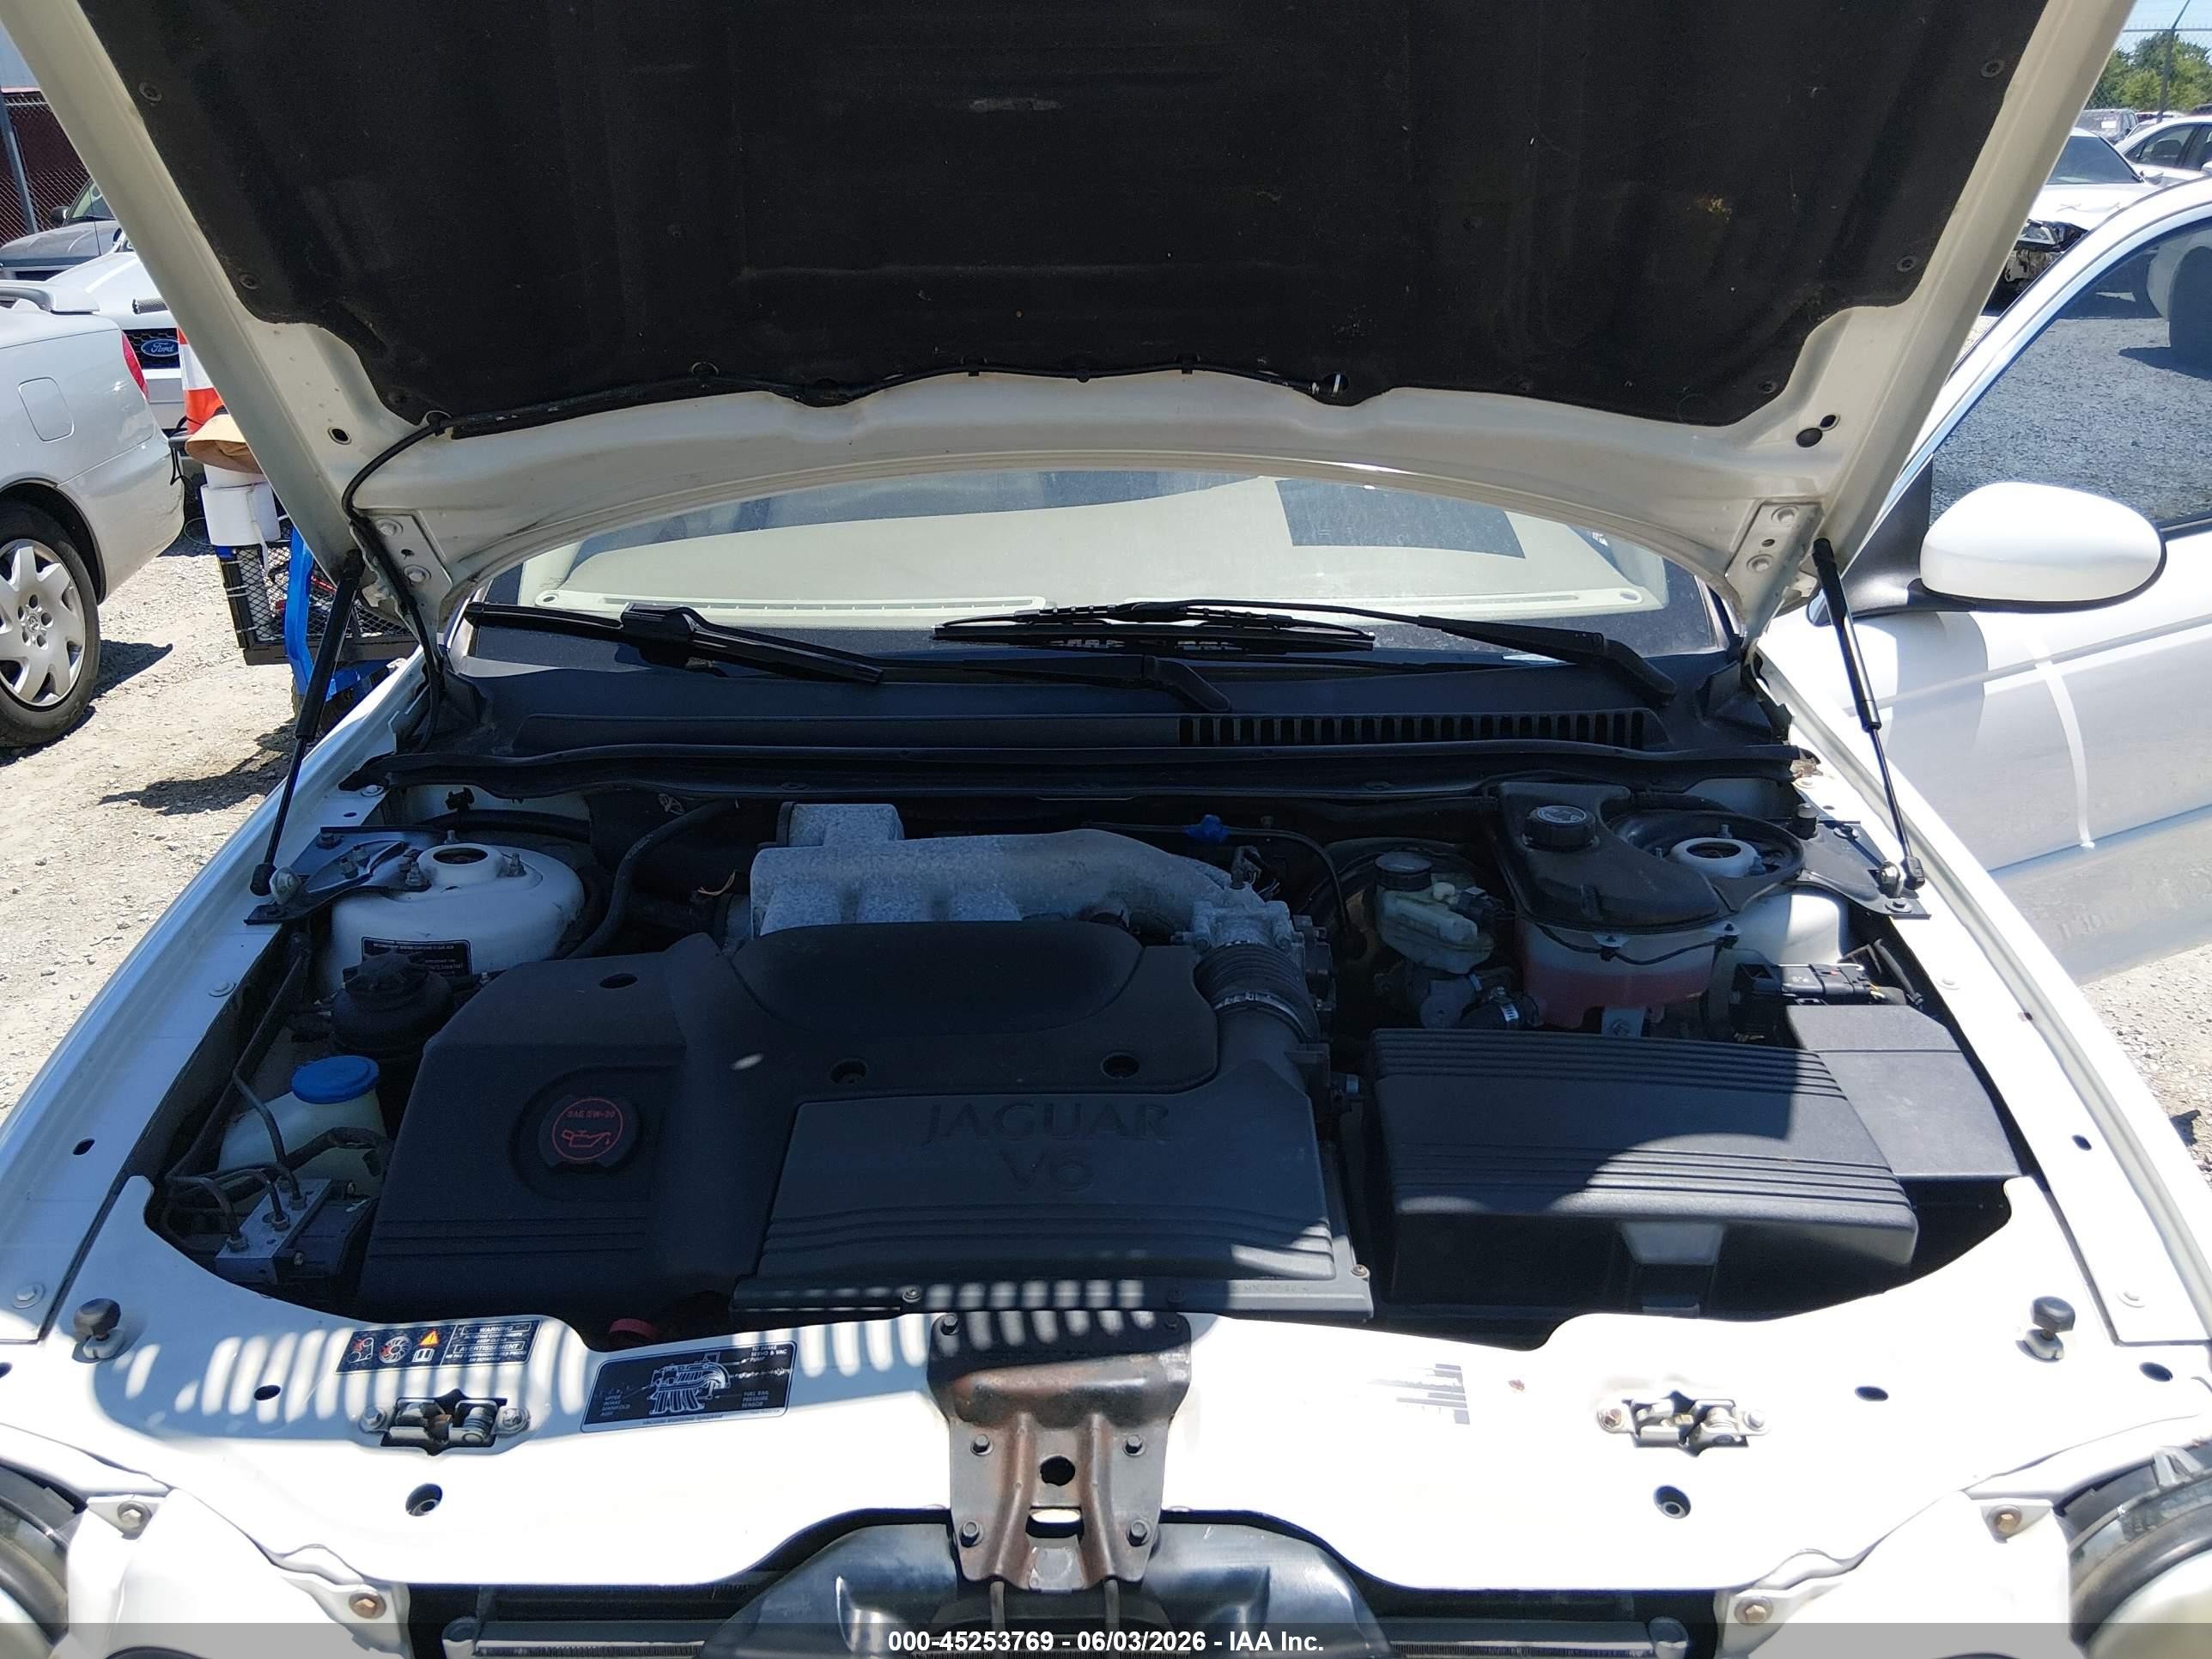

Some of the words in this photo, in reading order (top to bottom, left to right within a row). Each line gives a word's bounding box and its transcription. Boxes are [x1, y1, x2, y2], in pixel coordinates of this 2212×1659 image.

[150, 342, 175, 353] Ford
[921, 1103, 1171, 1147] JAGUAR
[999, 1149, 1095, 1192] V6
[459, 1343, 520, 1352] AVERTISSEMENT
